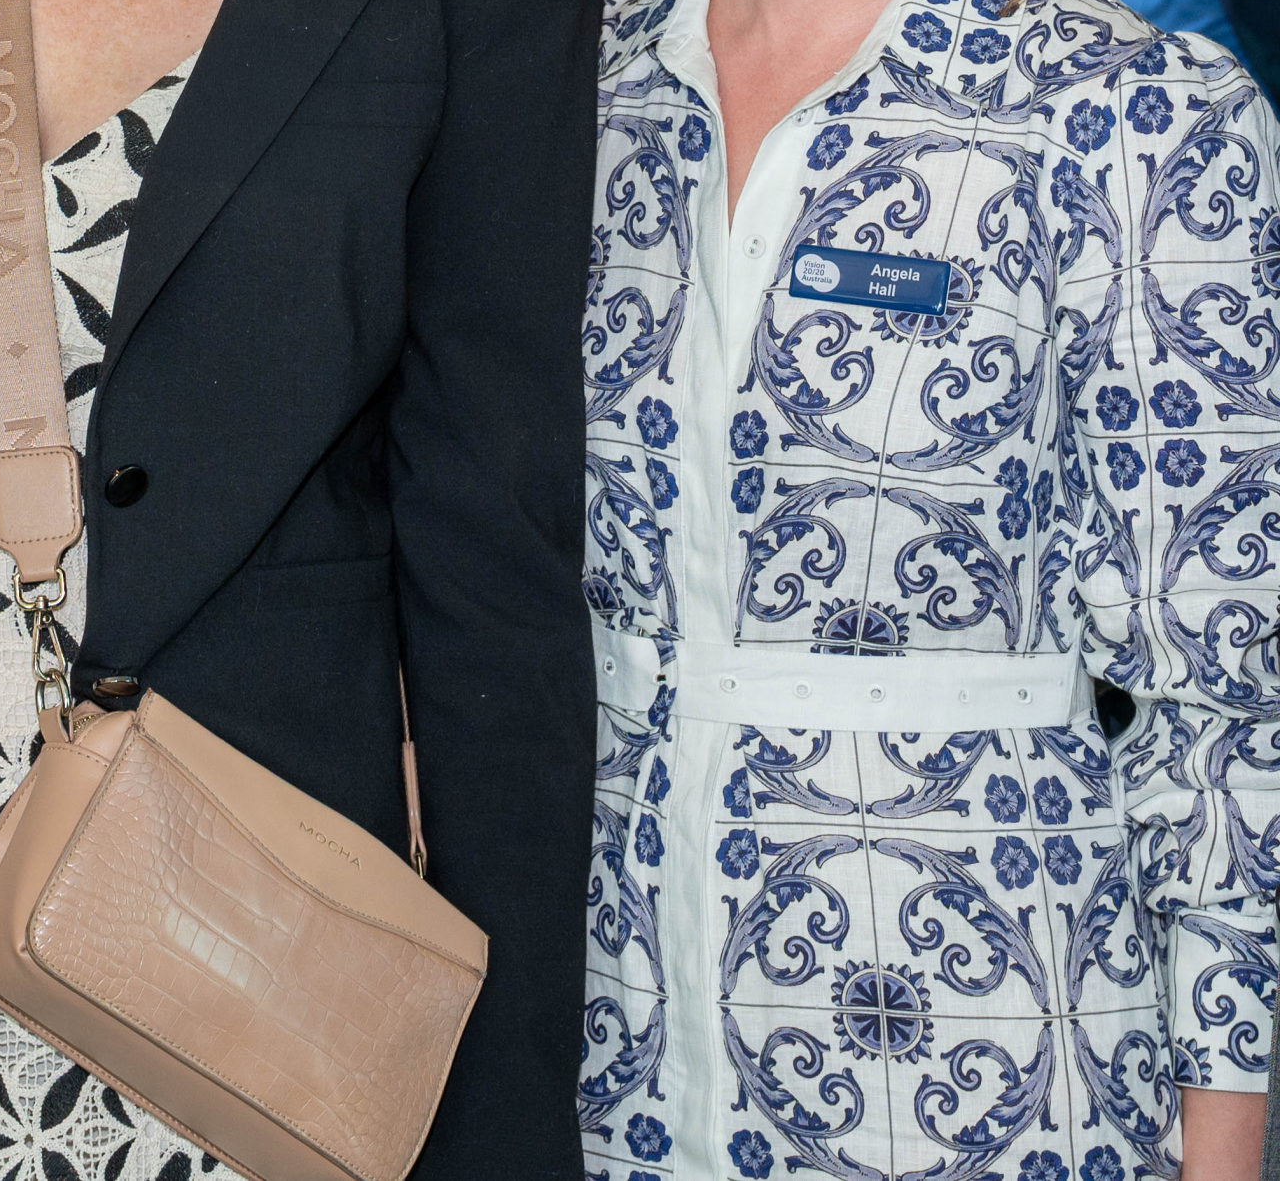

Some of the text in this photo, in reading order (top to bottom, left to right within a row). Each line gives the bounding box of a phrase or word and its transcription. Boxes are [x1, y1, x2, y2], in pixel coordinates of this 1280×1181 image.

[803, 260, 825, 269] Vision
[803, 267, 825, 276] 20/20
[870, 264, 920, 282] Angela
[801, 274, 833, 284] Australia
[869, 282, 896, 297] Hall
[299, 821, 362, 870] MOCHA
